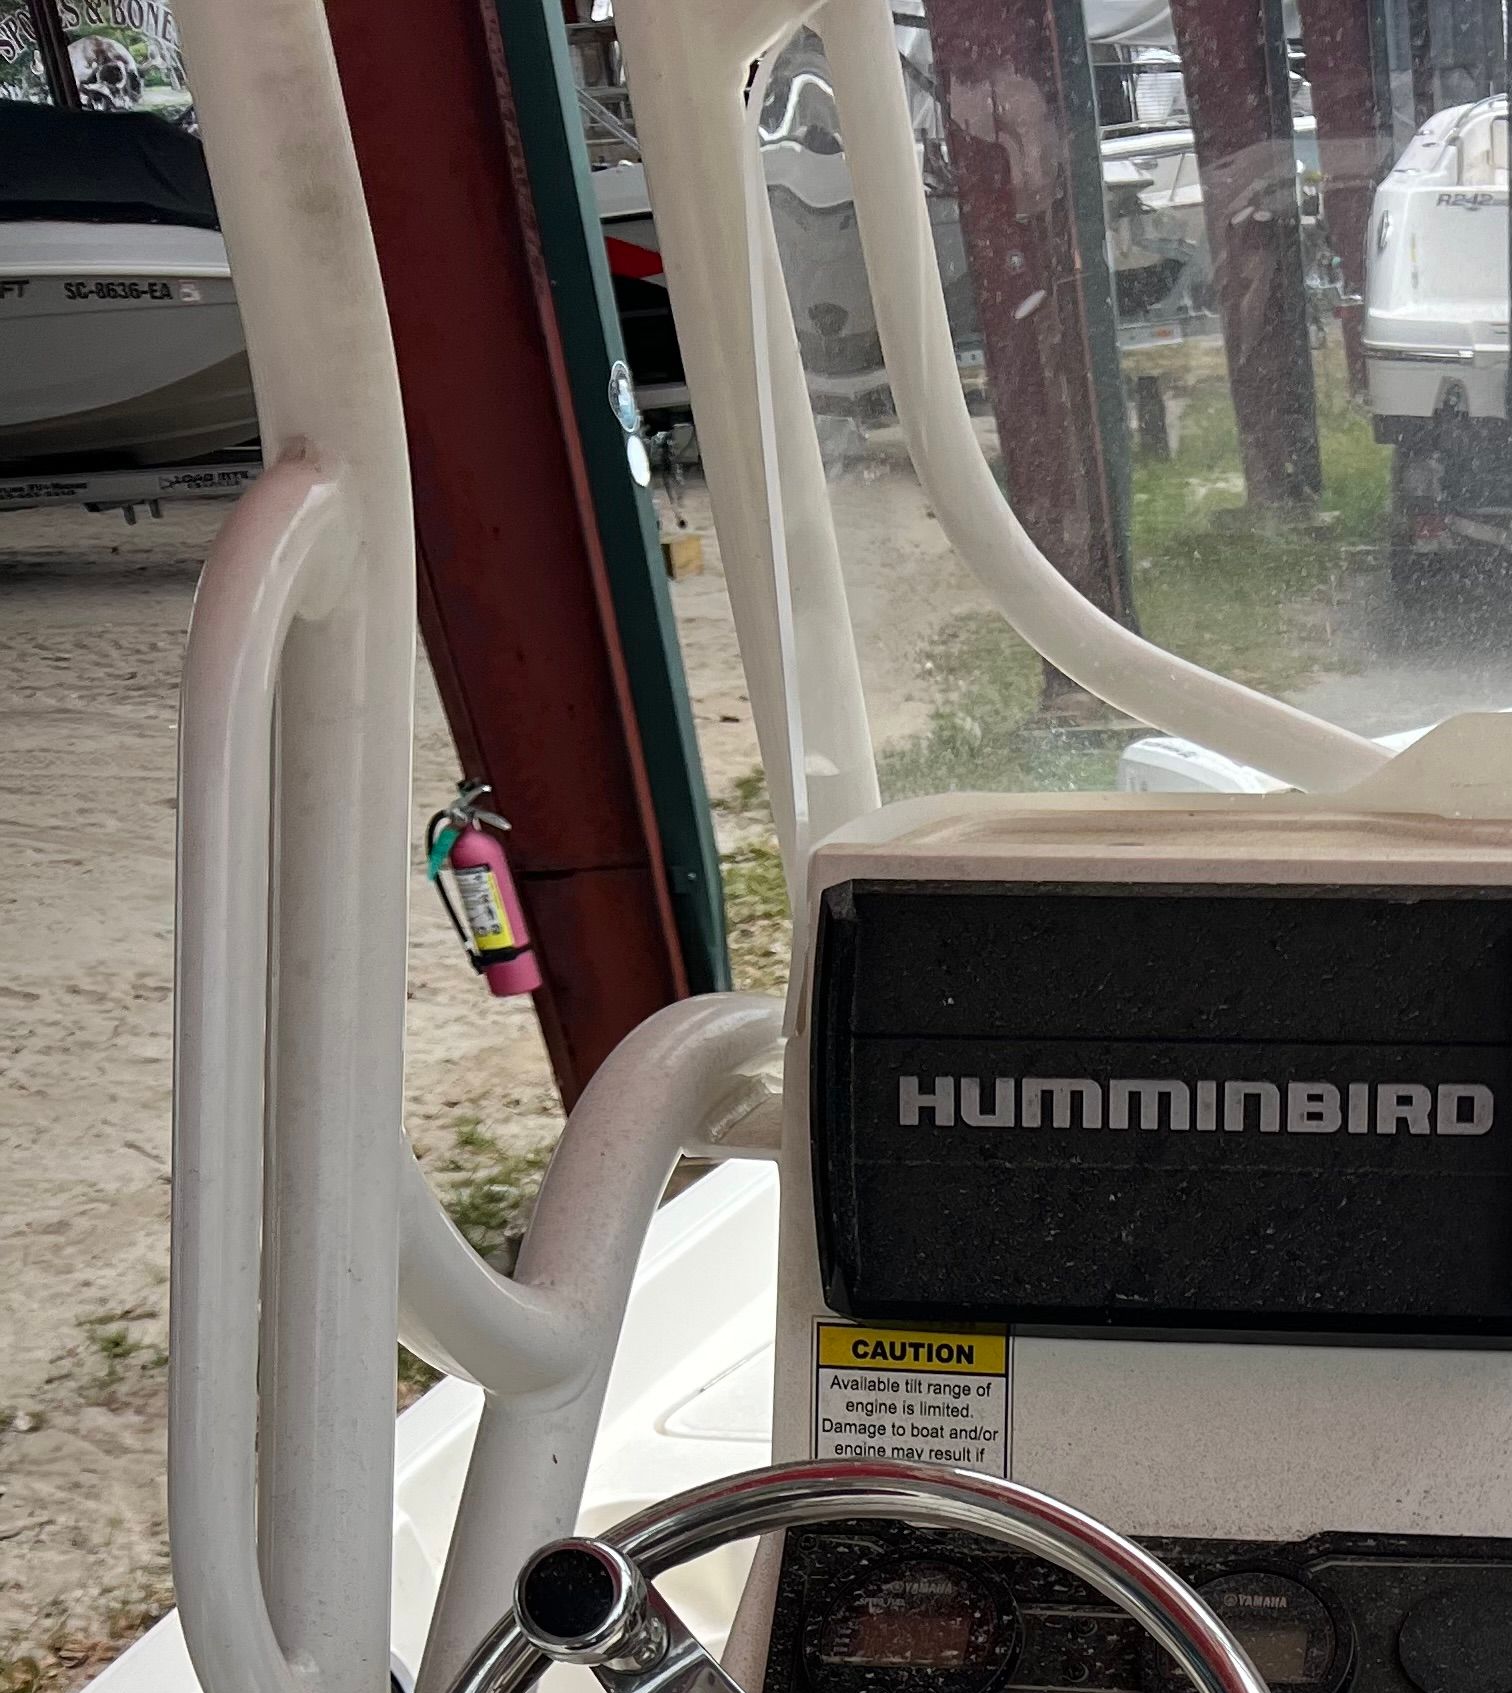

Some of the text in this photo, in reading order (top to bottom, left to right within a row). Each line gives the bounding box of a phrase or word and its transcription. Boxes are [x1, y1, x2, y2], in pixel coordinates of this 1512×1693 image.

[63, 282, 173, 300] SC-8636-EA
[899, 1076, 1493, 1135] HUMMINBIRD
[851, 1339, 975, 1365] CAUTION
[830, 1375, 993, 1399] Available tilt range of
[845, 1400, 975, 1418] engine is limited.
[822, 1418, 999, 1441] Damage to boat and/or
[834, 1442, 986, 1463] engine may result if
[1238, 1593, 1287, 1608] YAMAHA
